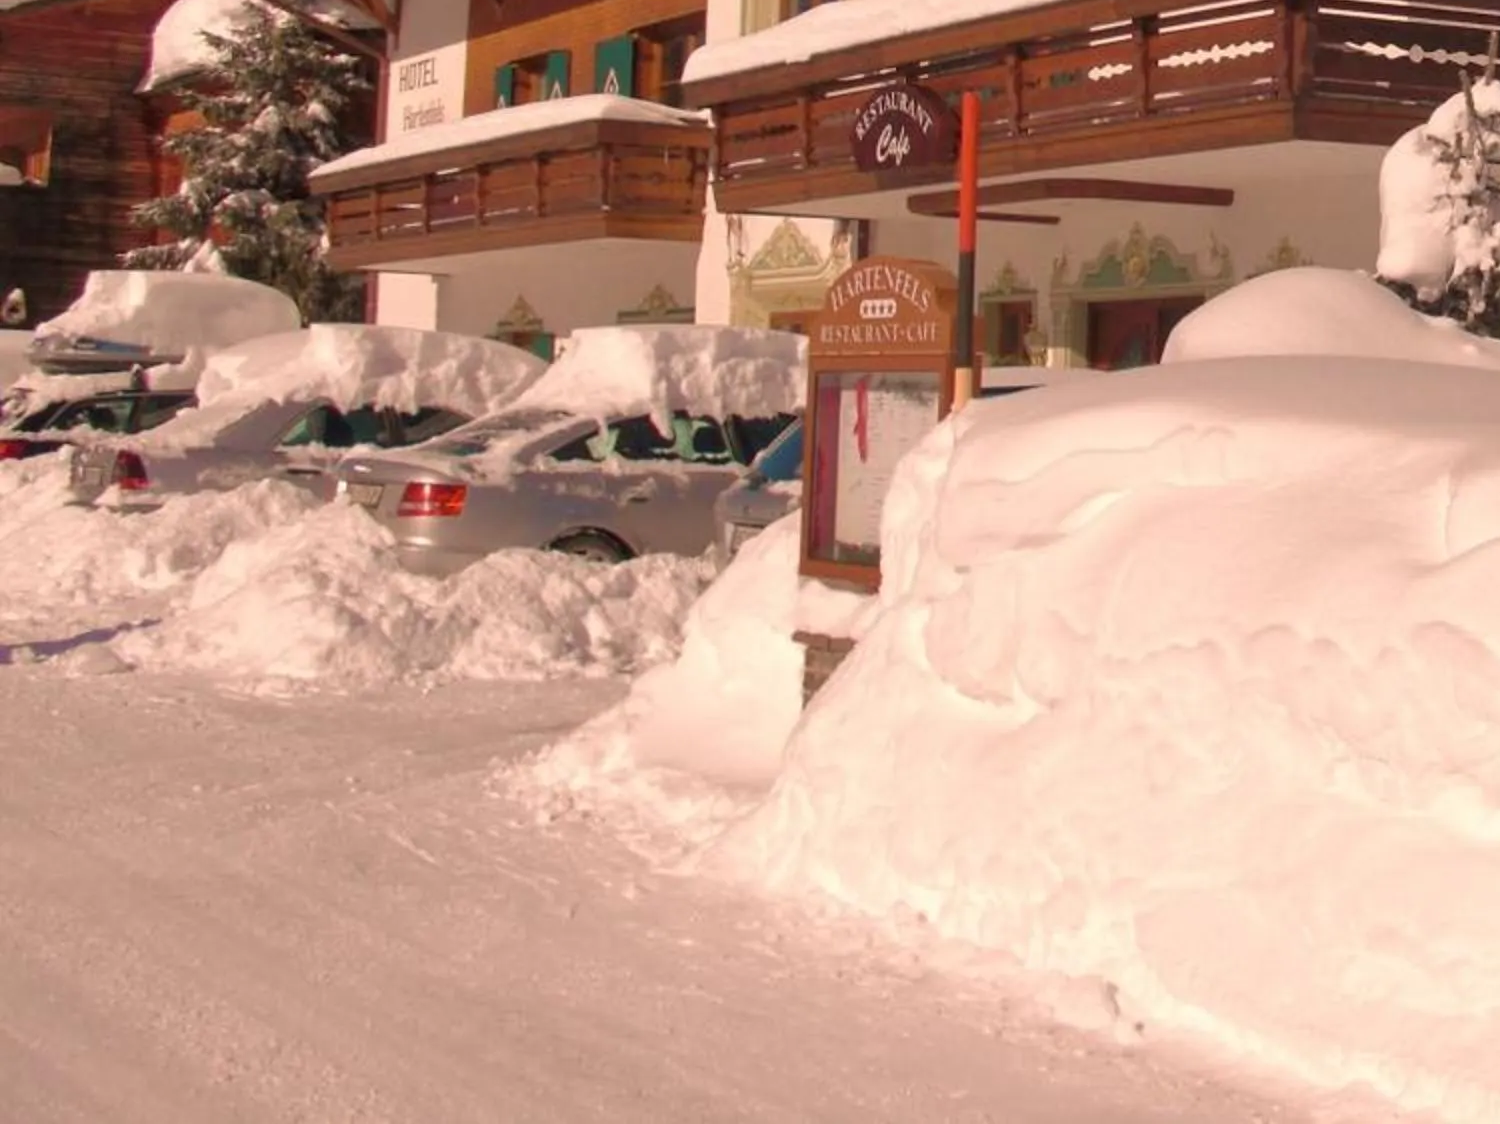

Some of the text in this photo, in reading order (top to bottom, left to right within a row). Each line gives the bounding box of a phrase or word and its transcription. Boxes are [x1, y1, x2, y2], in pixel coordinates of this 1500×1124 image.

[399, 57, 439, 92] HOTEL
[856, 91, 933, 141] RESTAURANT
[830, 265, 931, 313] HARTENFELS
